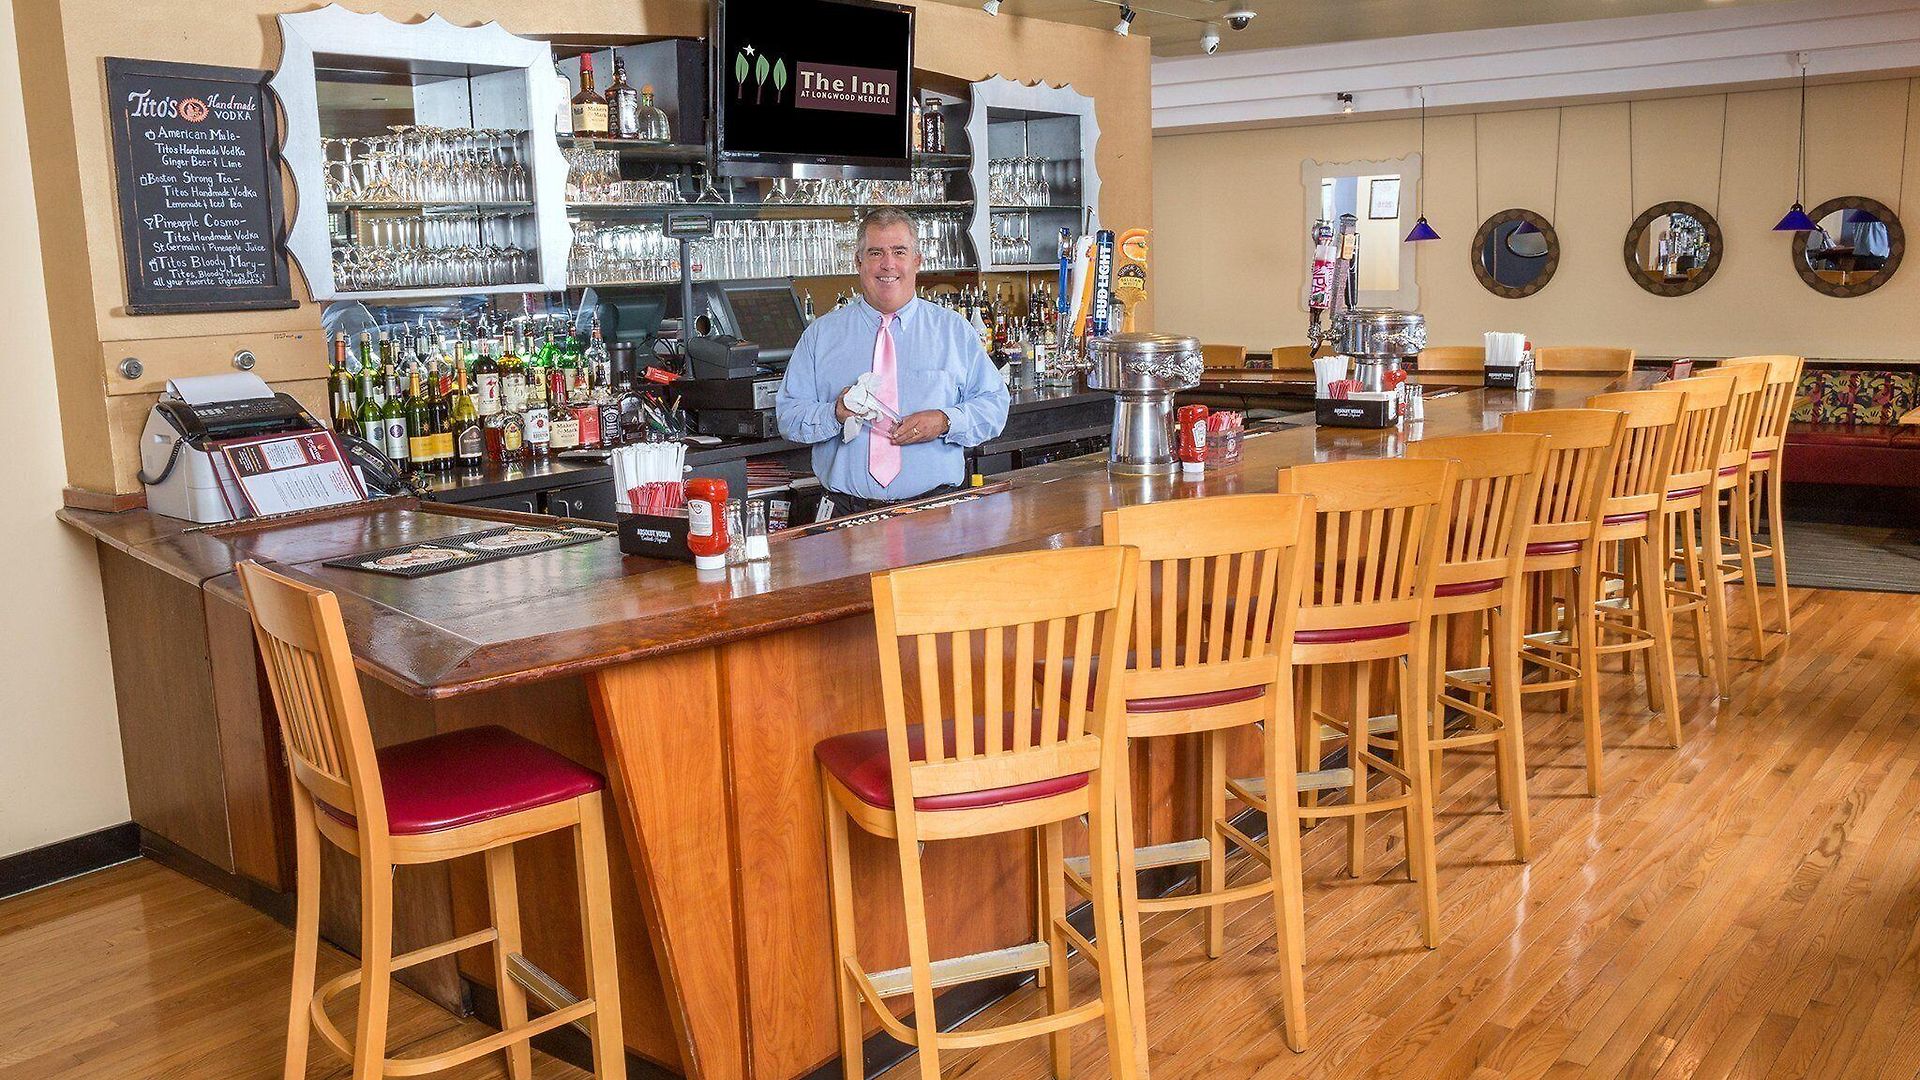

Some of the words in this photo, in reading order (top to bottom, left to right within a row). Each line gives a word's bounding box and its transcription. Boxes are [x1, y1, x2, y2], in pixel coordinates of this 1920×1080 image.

[801, 71, 845, 92] The
[851, 75, 891, 96] Inn
[128, 89, 178, 119] Tito's
[207, 94, 256, 111] Handmade
[801, 90, 809, 98] AT
[812, 91, 856, 102] LONGWOOD
[858, 94, 890, 104] MEDICAL
[214, 110, 251, 120] VODKA
[158, 126, 207, 140] American
[155, 143, 178, 154] Titos
[180, 144, 219, 156] Handmade
[162, 154, 189, 169] Ginger
[191, 156, 210, 167] Beer
[221, 158, 242, 168] Lime
[147, 173, 177, 185] Boston
[183, 171, 214, 187] Strong
[162, 185, 189, 197] Titos
[191, 186, 230, 198] Handmade
[165, 199, 201, 209] Lemonade
[210, 199, 225, 208] Iced
[228, 198, 242, 209] Tea
[153, 213, 199, 231] Pineapple
[163, 231, 191, 244] Titos
[193, 230, 232, 241] Handmade
[208, 243, 242, 254] Pineapple
[244, 243, 266, 252] Juice
[157, 256, 187, 269] Titos
[190, 254, 226, 272] Bloody
[1098, 246, 1110, 288] LIGHT
[199, 269, 224, 278] Bloody
[226, 269, 245, 279] Mary
[153, 278, 163, 286] all
[166, 279, 183, 288] your
[185, 278, 215, 287] favorite
[1096, 290, 1108, 318] BUD
